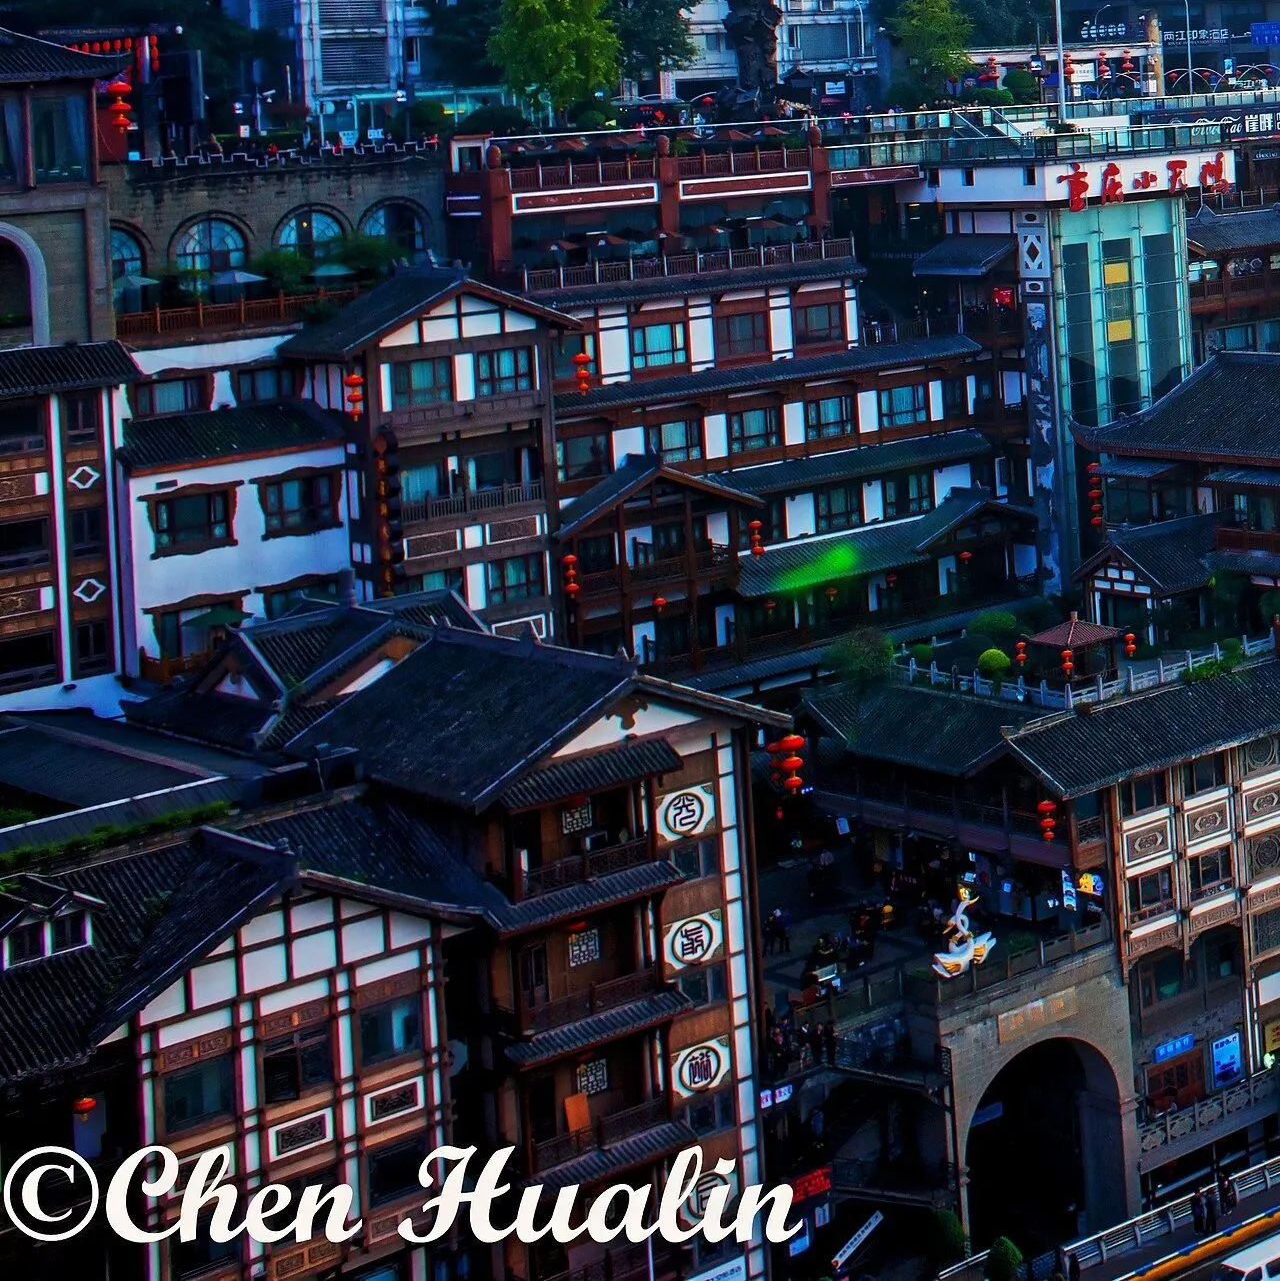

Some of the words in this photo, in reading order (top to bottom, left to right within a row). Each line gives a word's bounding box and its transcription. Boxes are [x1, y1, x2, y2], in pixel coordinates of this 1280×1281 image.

[1163, 28, 1229, 42] 两江印象酒店
